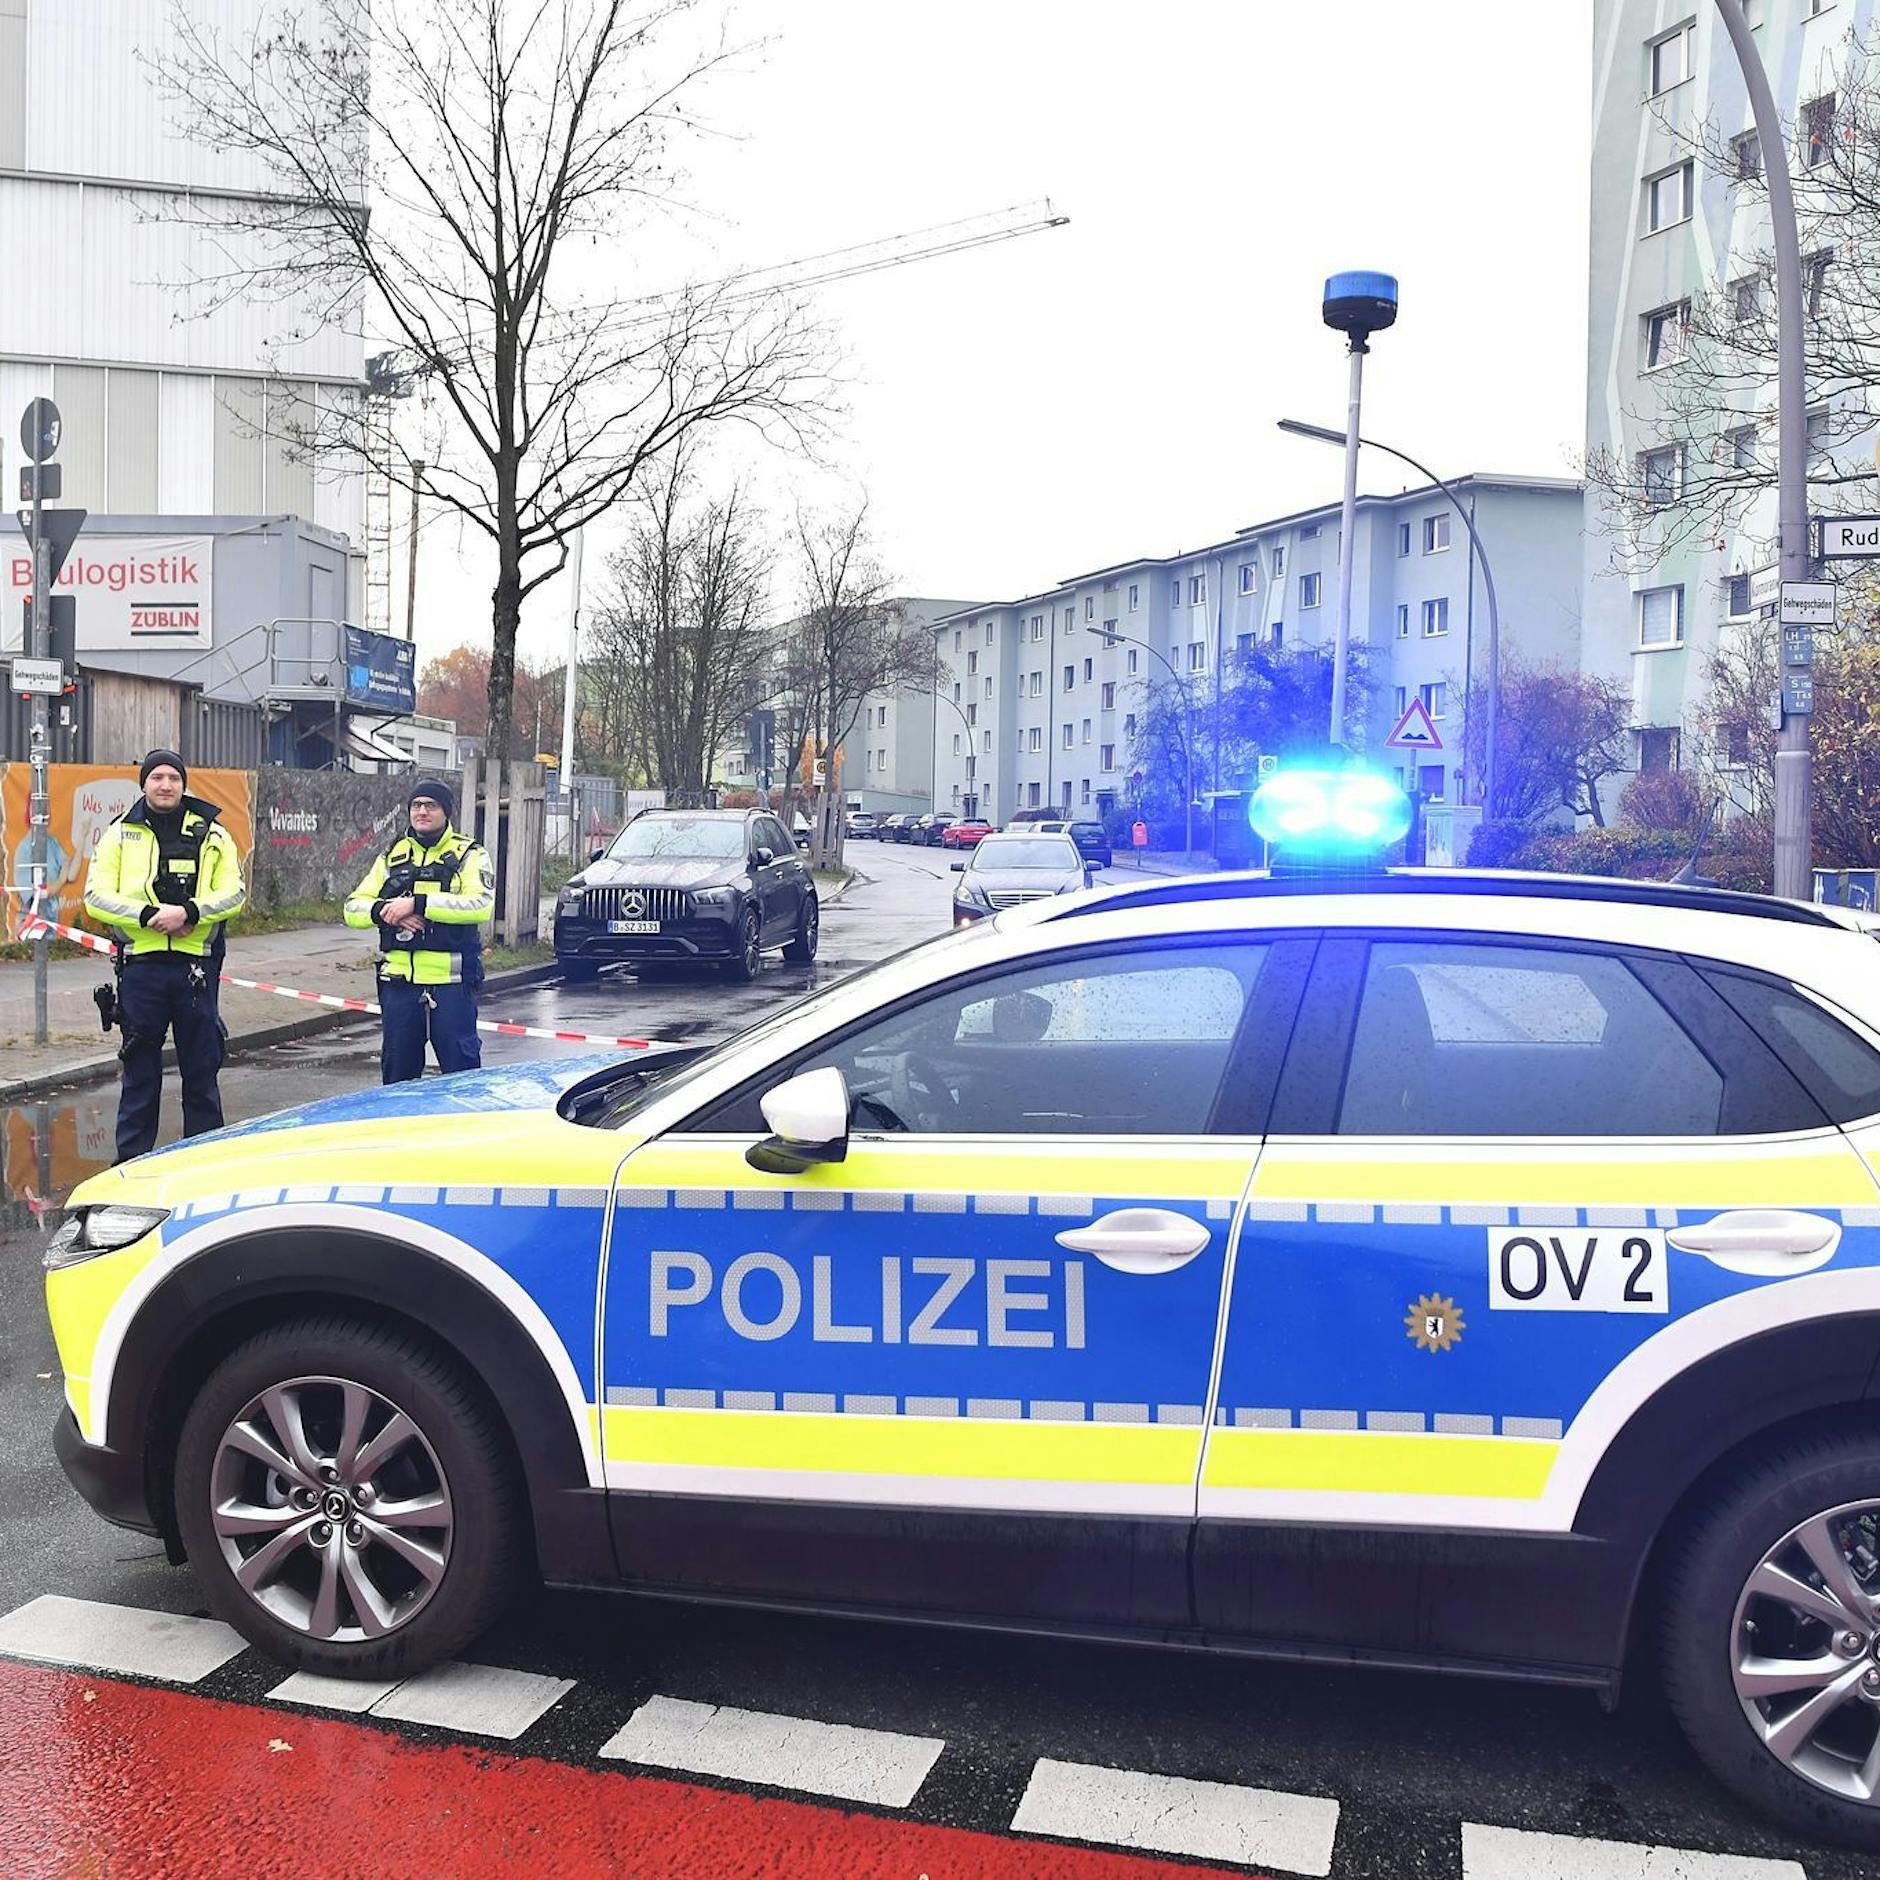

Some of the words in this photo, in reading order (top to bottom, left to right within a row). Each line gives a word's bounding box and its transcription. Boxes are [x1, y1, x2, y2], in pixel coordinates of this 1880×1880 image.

[1842, 527, 1878, 546] Rud
[11, 556, 199, 592] Bulogistik
[131, 611, 200, 628] ZÜBLIN
[270, 805, 318, 832] Vivantes
[624, 923, 636, 931] SZ
[637, 923, 658, 931] 3131
[1500, 1236, 1598, 1301] OV
[1621, 1237, 1653, 1302] 2
[649, 1250, 1086, 1349] POLIZEI
